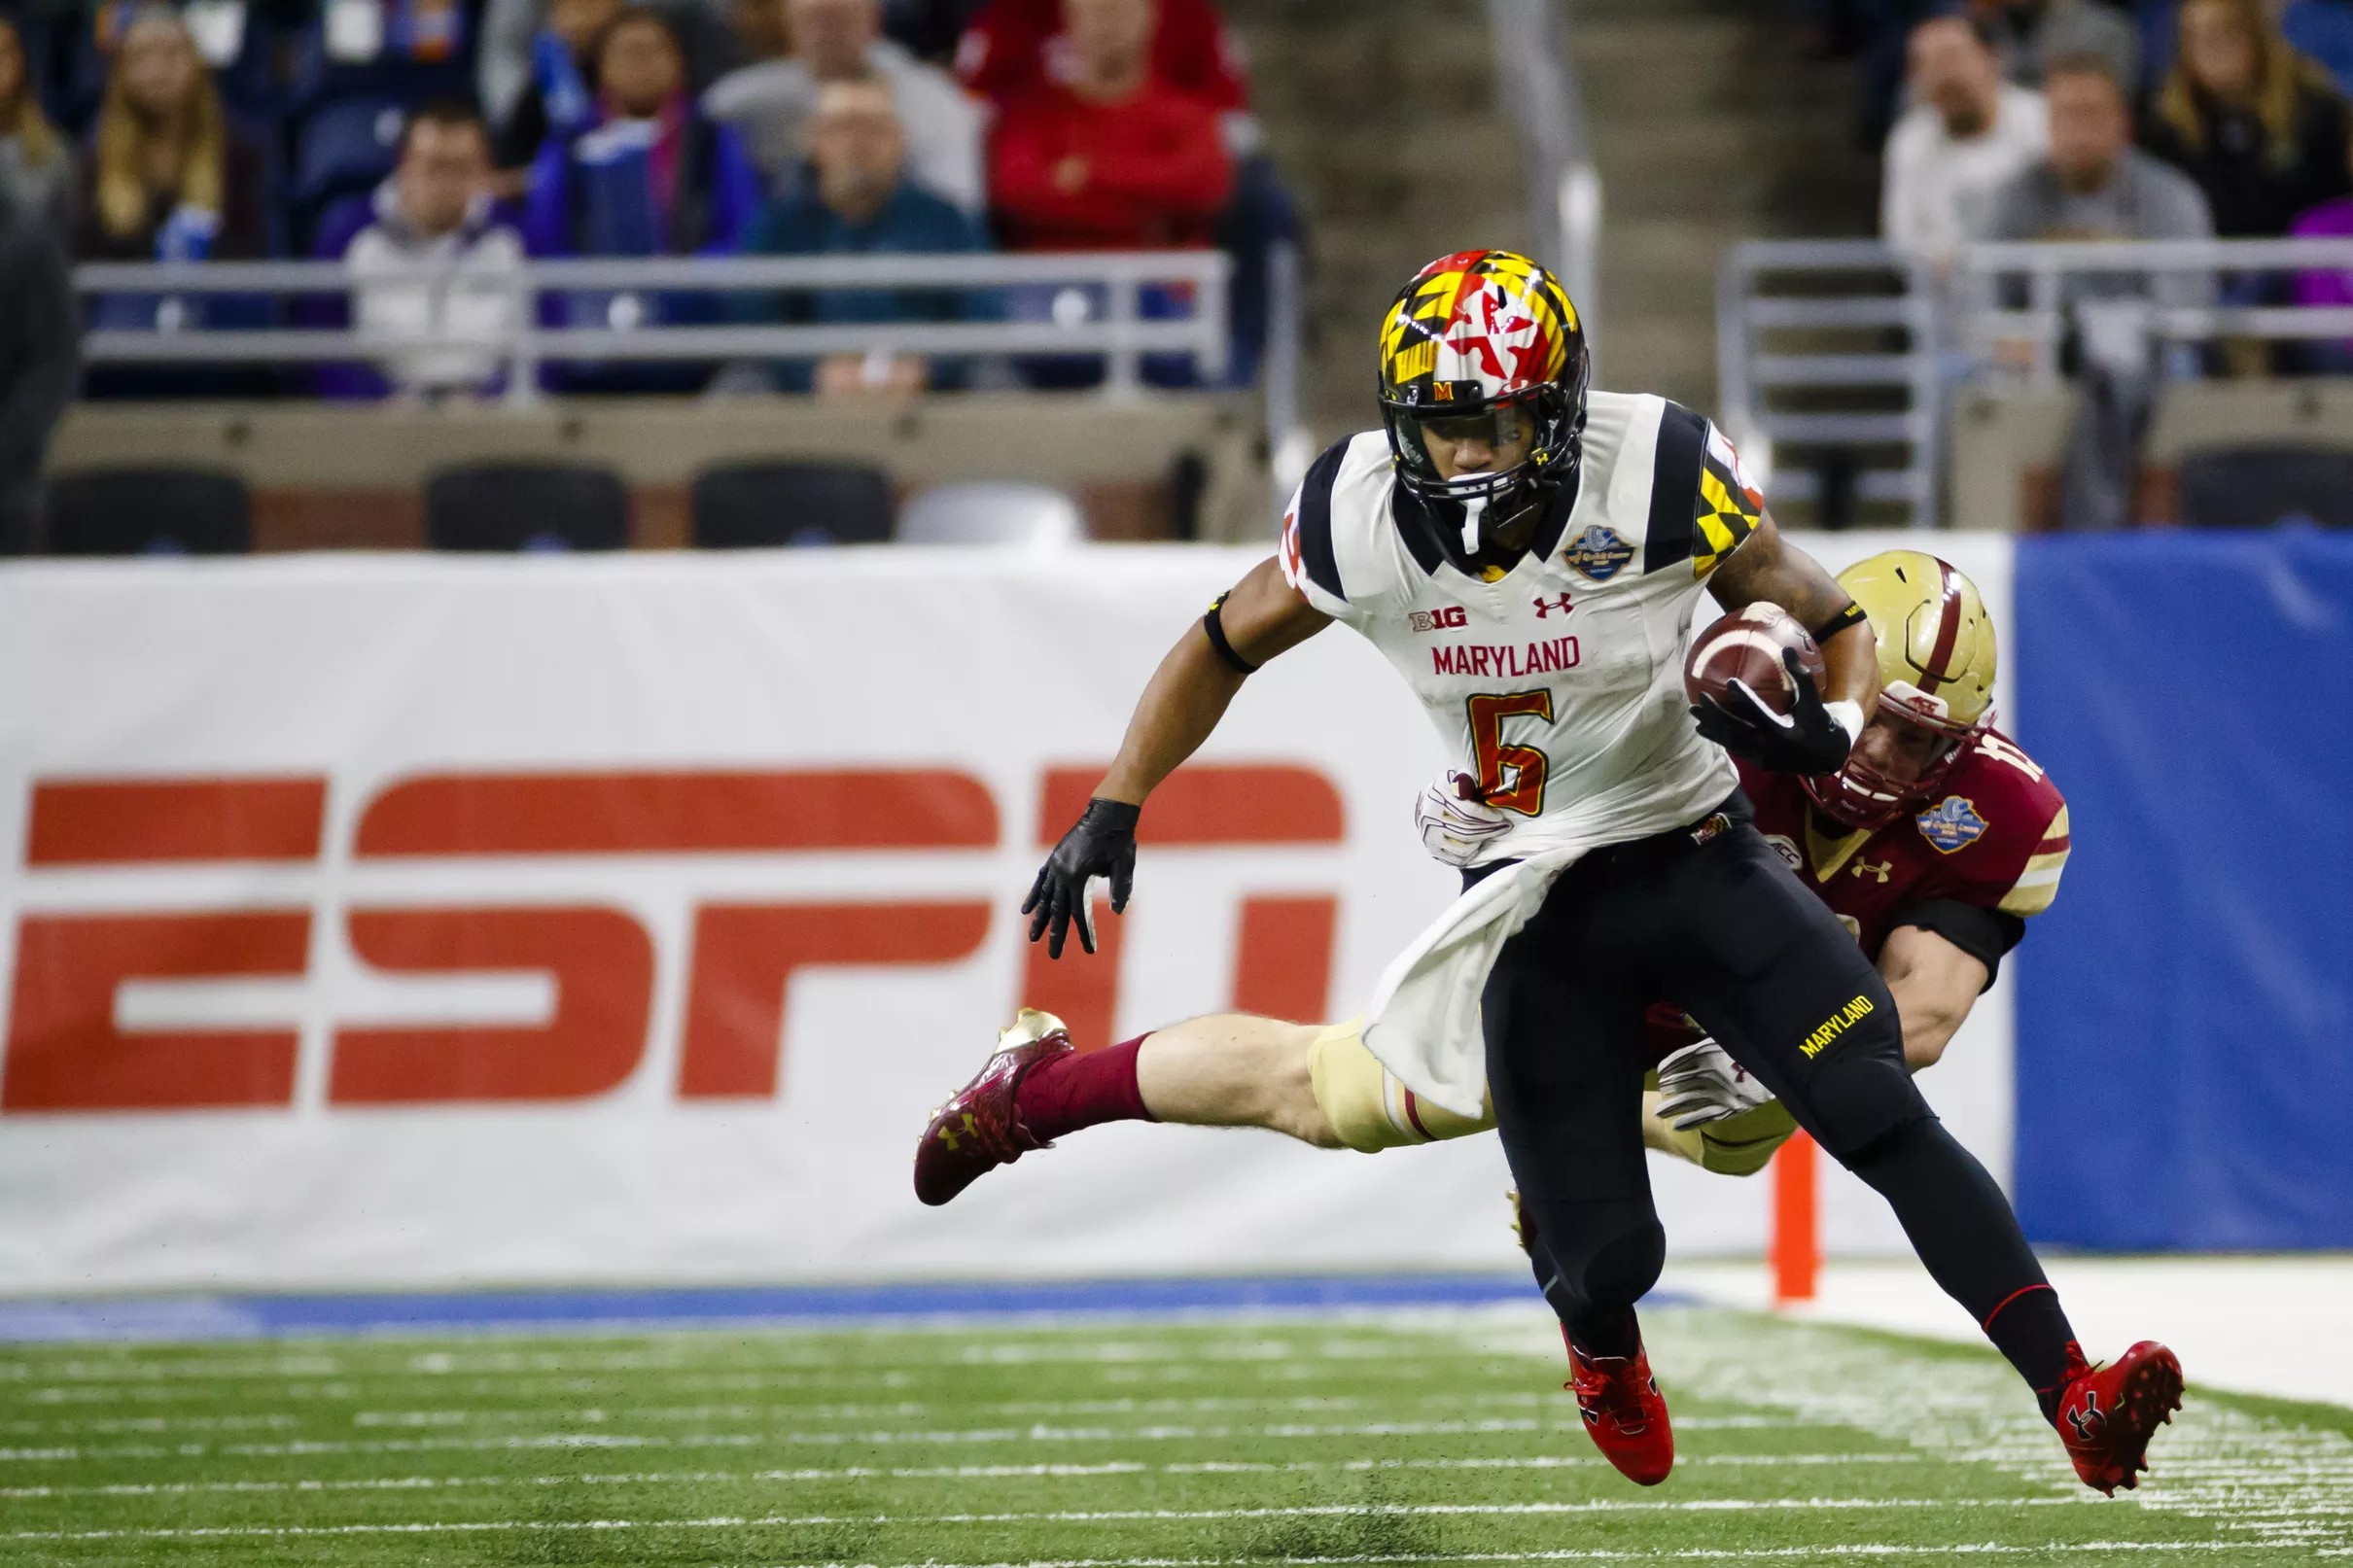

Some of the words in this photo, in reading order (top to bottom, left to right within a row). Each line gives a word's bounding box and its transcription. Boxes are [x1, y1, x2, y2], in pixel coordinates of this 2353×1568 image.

[1433, 381, 1454, 401] M
[1431, 636, 1581, 678] MARYLAND
[1465, 687, 1556, 818] 6
[0, 762, 1348, 1113] ESPN
[1799, 994, 1875, 1060] MARYLAND
